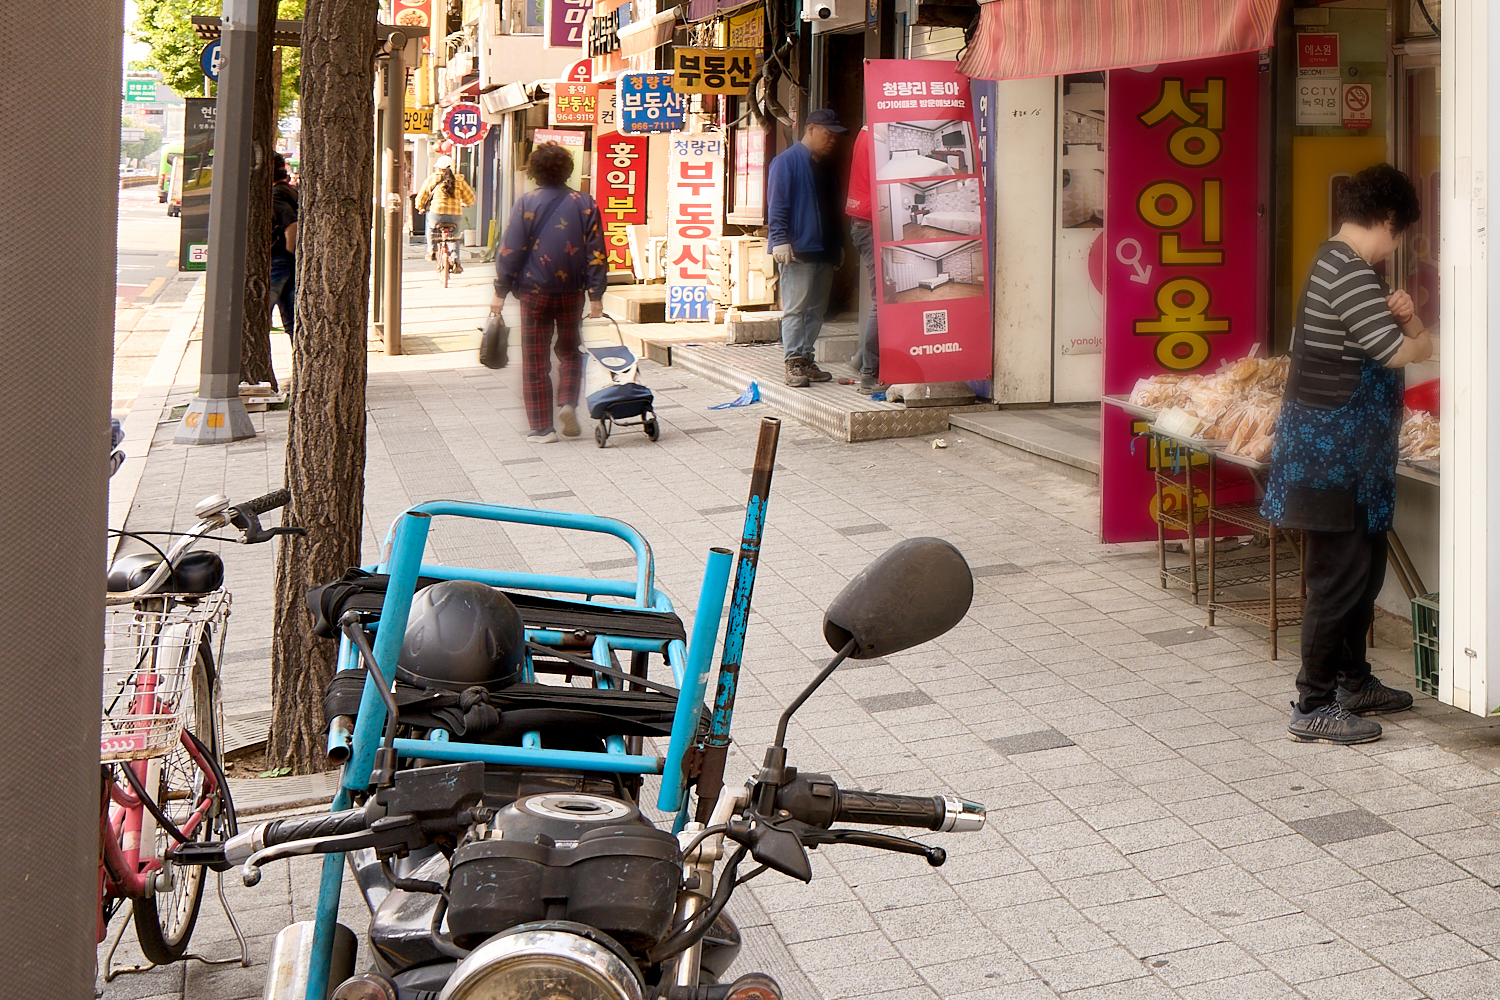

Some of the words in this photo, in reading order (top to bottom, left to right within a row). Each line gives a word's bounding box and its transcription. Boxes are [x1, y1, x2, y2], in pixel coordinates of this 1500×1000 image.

[1304, 44, 1332, 56] 에스원
[677, 54, 752, 89] 부동산
[567, 85, 587, 95] 홍익
[882, 81, 927, 97] 청량리
[930, 81, 959, 96] 동아
[1300, 86, 1338, 96] CCTV
[556, 95, 596, 113] 부동산
[623, 91, 682, 119] 부동산
[877, 99, 918, 110] 여기어때로
[919, 99, 966, 109] 방문해보세요
[1301, 98, 1336, 108] 녹화중
[453, 113, 478, 126] 커피
[556, 113, 595, 122] 964-9119
[631, 121, 675, 131] 966-7111
[674, 139, 721, 157] 청량리
[605, 142, 639, 195] 홍익
[671, 160, 714, 281] 부동산
[602, 195, 638, 273] 부동산
